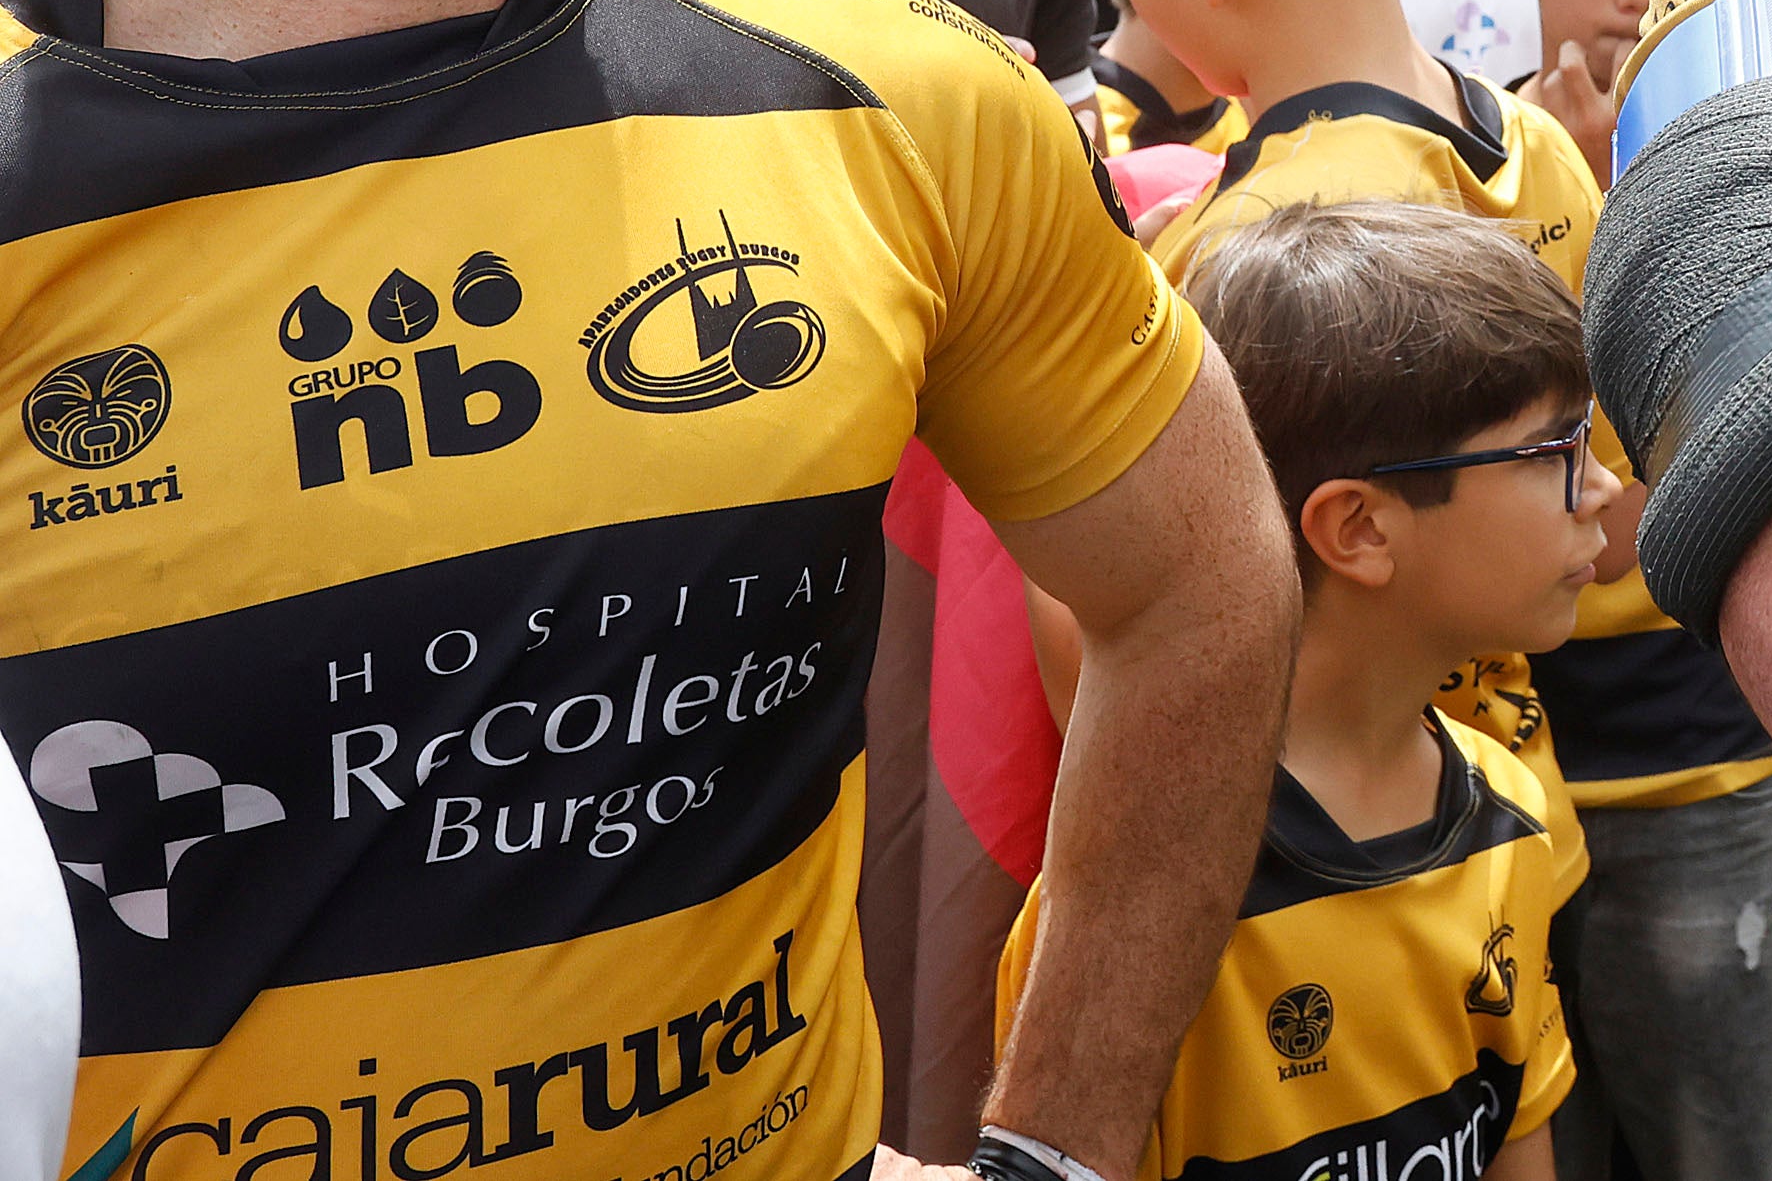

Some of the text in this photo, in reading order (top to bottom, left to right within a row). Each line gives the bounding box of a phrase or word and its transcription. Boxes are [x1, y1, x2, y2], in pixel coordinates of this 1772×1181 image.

[908, 0, 1027, 82] constructora
[577, 243, 800, 350] APAREJADORES RUGBY BURGOS
[288, 356, 402, 398] GRUPO
[290, 344, 542, 491] nb
[28, 464, 184, 530] kāuri
[328, 556, 849, 703] HOSPITAL
[331, 641, 822, 820] Recoletas
[425, 766, 725, 864] Burgos
[132, 928, 807, 1181] cajarural
